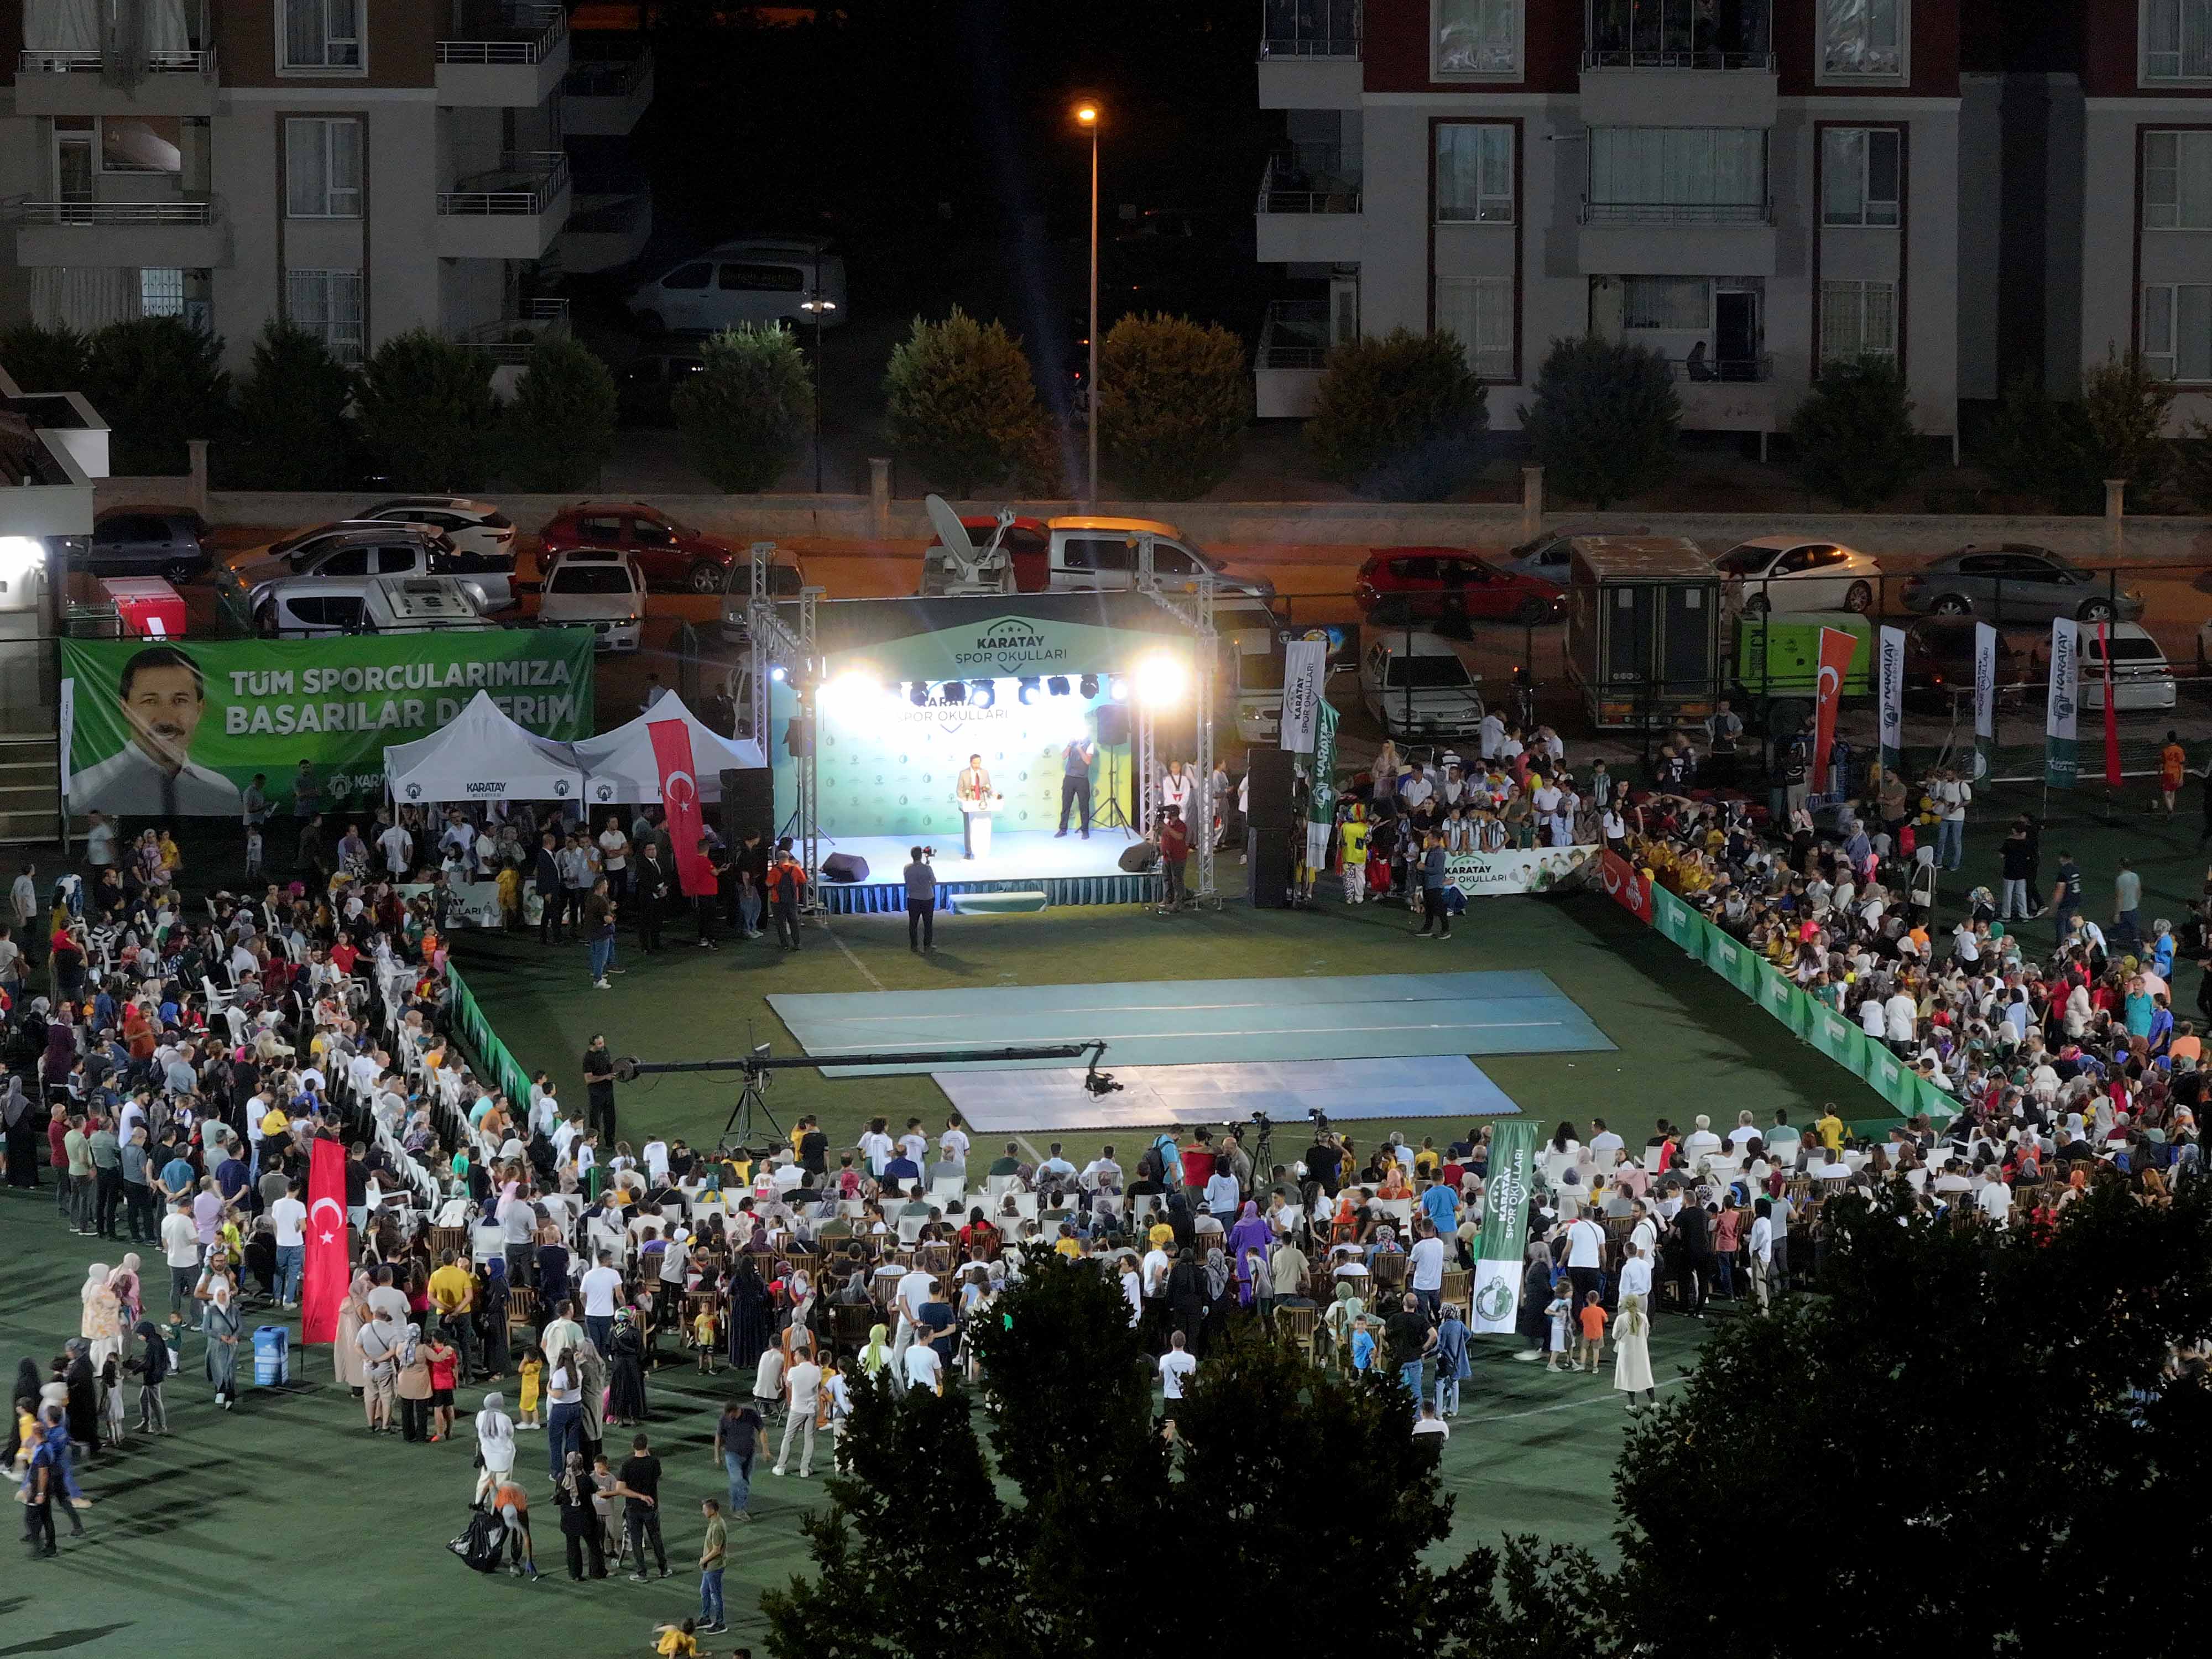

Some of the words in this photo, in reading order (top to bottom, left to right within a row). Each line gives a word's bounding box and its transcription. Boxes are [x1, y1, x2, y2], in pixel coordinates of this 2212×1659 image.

[977, 635, 1045, 649] KARATAY
[955, 652, 992, 664] SPOR
[997, 649, 1067, 662] OKULLARI
[228, 670, 294, 696] TÜM
[302, 659, 572, 695] SPORCULARIMIZA
[1304, 663, 1314, 707] OKULLARI
[1294, 677, 1304, 720] KARATAY
[226, 697, 425, 736] BAŞARILAR
[938, 709, 1008, 721] OKULLARI
[1301, 709, 1310, 734] SPOR
[466, 782, 507, 792] KARATAY
[1444, 865, 1491, 874] KARATAY
[1458, 874, 1507, 883] OKULLARI
[1509, 1149, 1524, 1206] OKULLARI
[1498, 1166, 1511, 1222] KARATAY
[1505, 1207, 1516, 1239] SPOR
